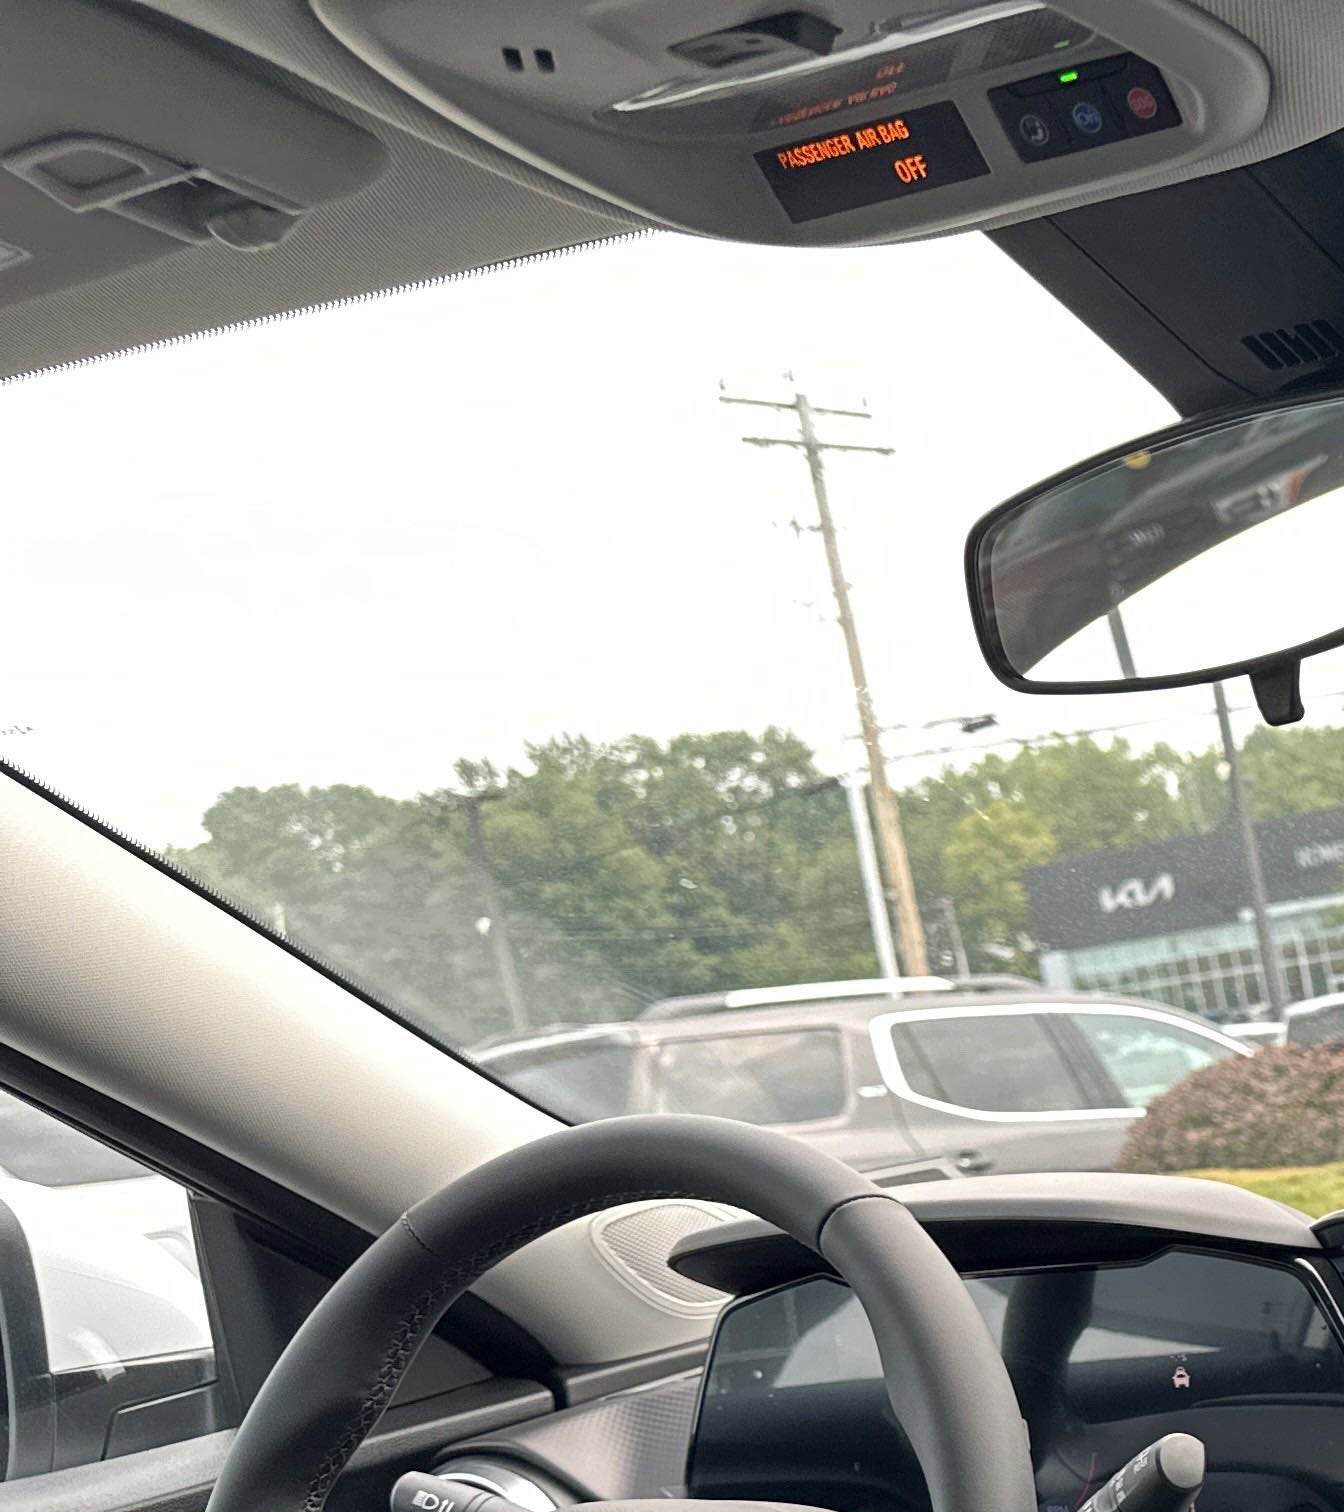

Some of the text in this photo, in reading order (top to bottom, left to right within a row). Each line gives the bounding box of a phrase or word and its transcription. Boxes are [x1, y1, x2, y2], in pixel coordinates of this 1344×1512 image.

[777, 119, 910, 169] PASSENGER AIR BAG
[894, 154, 928, 183] OFF
